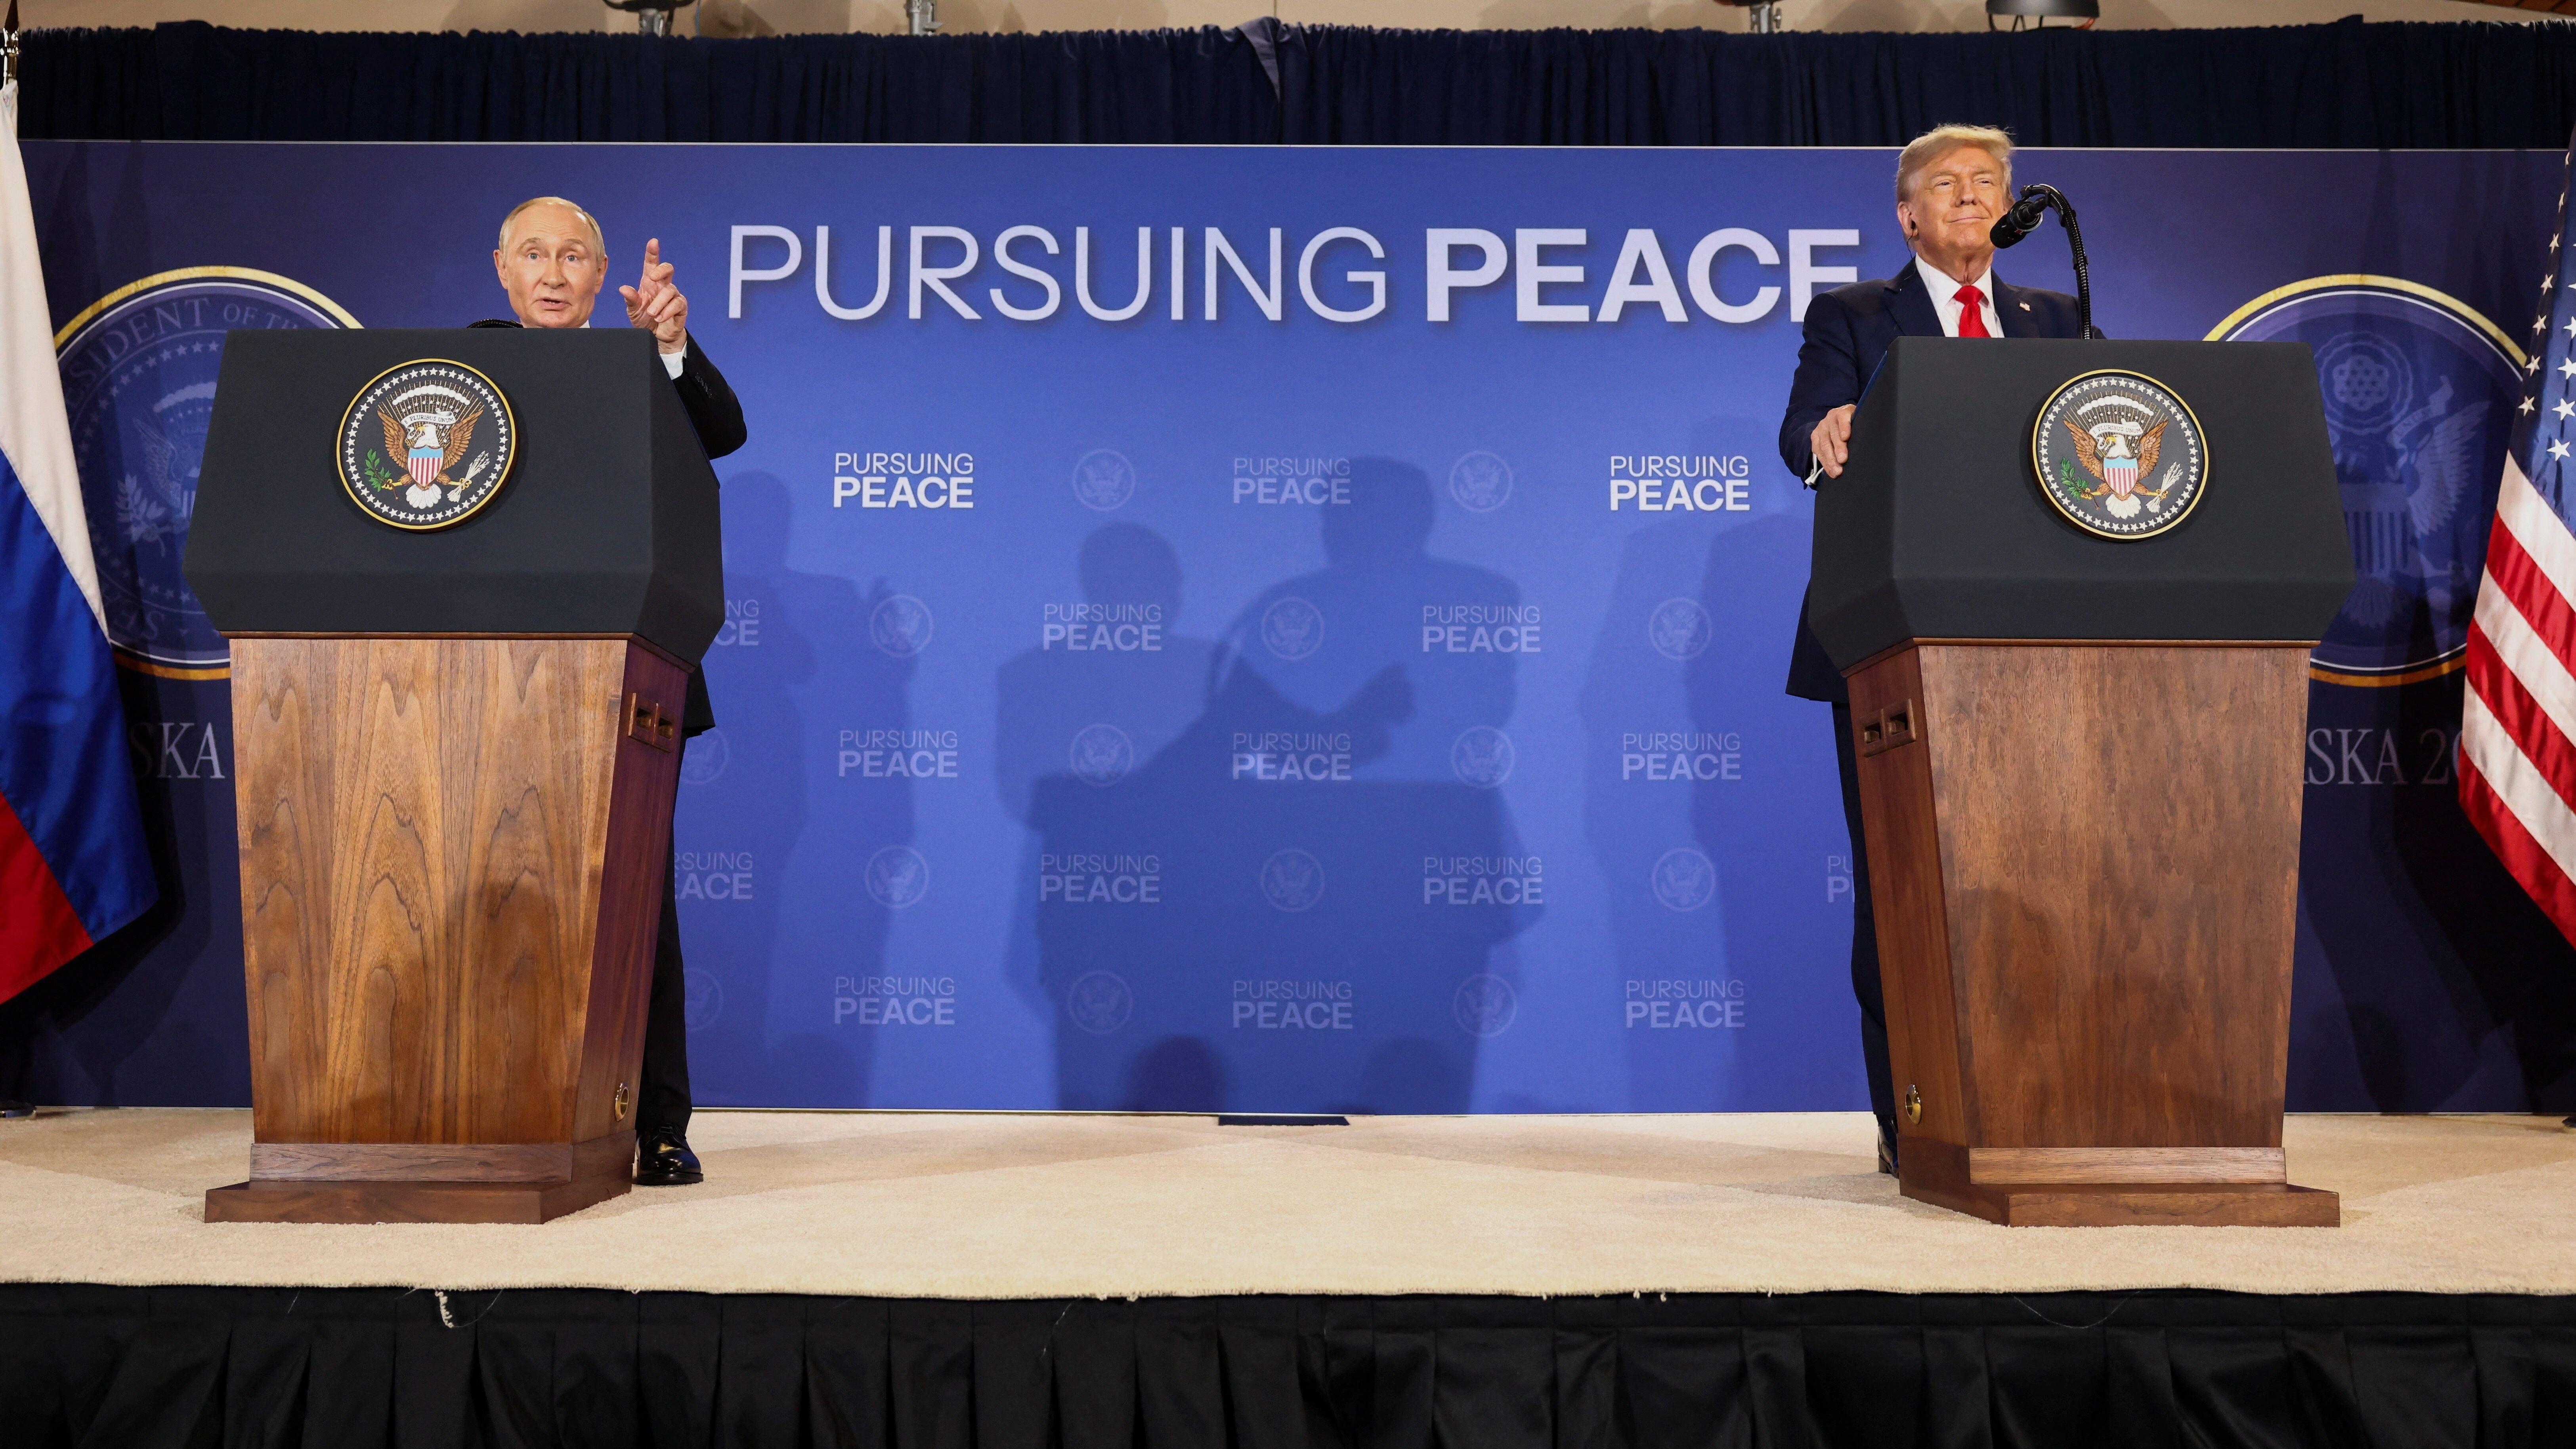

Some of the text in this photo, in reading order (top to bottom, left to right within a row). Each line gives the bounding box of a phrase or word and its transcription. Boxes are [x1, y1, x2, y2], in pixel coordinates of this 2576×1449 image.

[728, 225, 1859, 323] PURSUING PEACE
[224, 304, 258, 325] OF
[835, 453, 973, 474] PURSUING
[1234, 458, 1350, 475] PURSUING
[1611, 456, 1748, 476] PURSUING
[834, 477, 973, 508] PEACE
[1233, 478, 1351, 505] PEACE
[1610, 480, 1750, 510] PEACE
[1044, 604, 1161, 622] PURSUING
[1423, 606, 1540, 623] PURSUING
[1043, 624, 1162, 651] PEACE
[1423, 626, 1540, 652] PEACE
[840, 730, 957, 748] PURSUING
[1233, 732, 1350, 751] PURSUING
[1623, 732, 1740, 751] PURSUING
[839, 751, 958, 777] PEACE
[1233, 753, 1352, 781] PEACE
[1622, 753, 1741, 780] PEACE
[2303, 728, 2409, 785] SKA
[1041, 854, 1159, 873] PURSUING
[1424, 856, 1542, 875] PURSUING
[675, 873, 753, 899] ACE
[1041, 875, 1160, 902] PEACE
[1424, 877, 1543, 904] PEACE
[836, 977, 954, 995] PURSUING
[1233, 980, 1352, 1000] PURSUING
[1626, 980, 1743, 998] PURSUING
[835, 998, 955, 1025] PEACE
[1233, 1001, 1353, 1029] PEACE
[1626, 1001, 1745, 1028] PEACE
